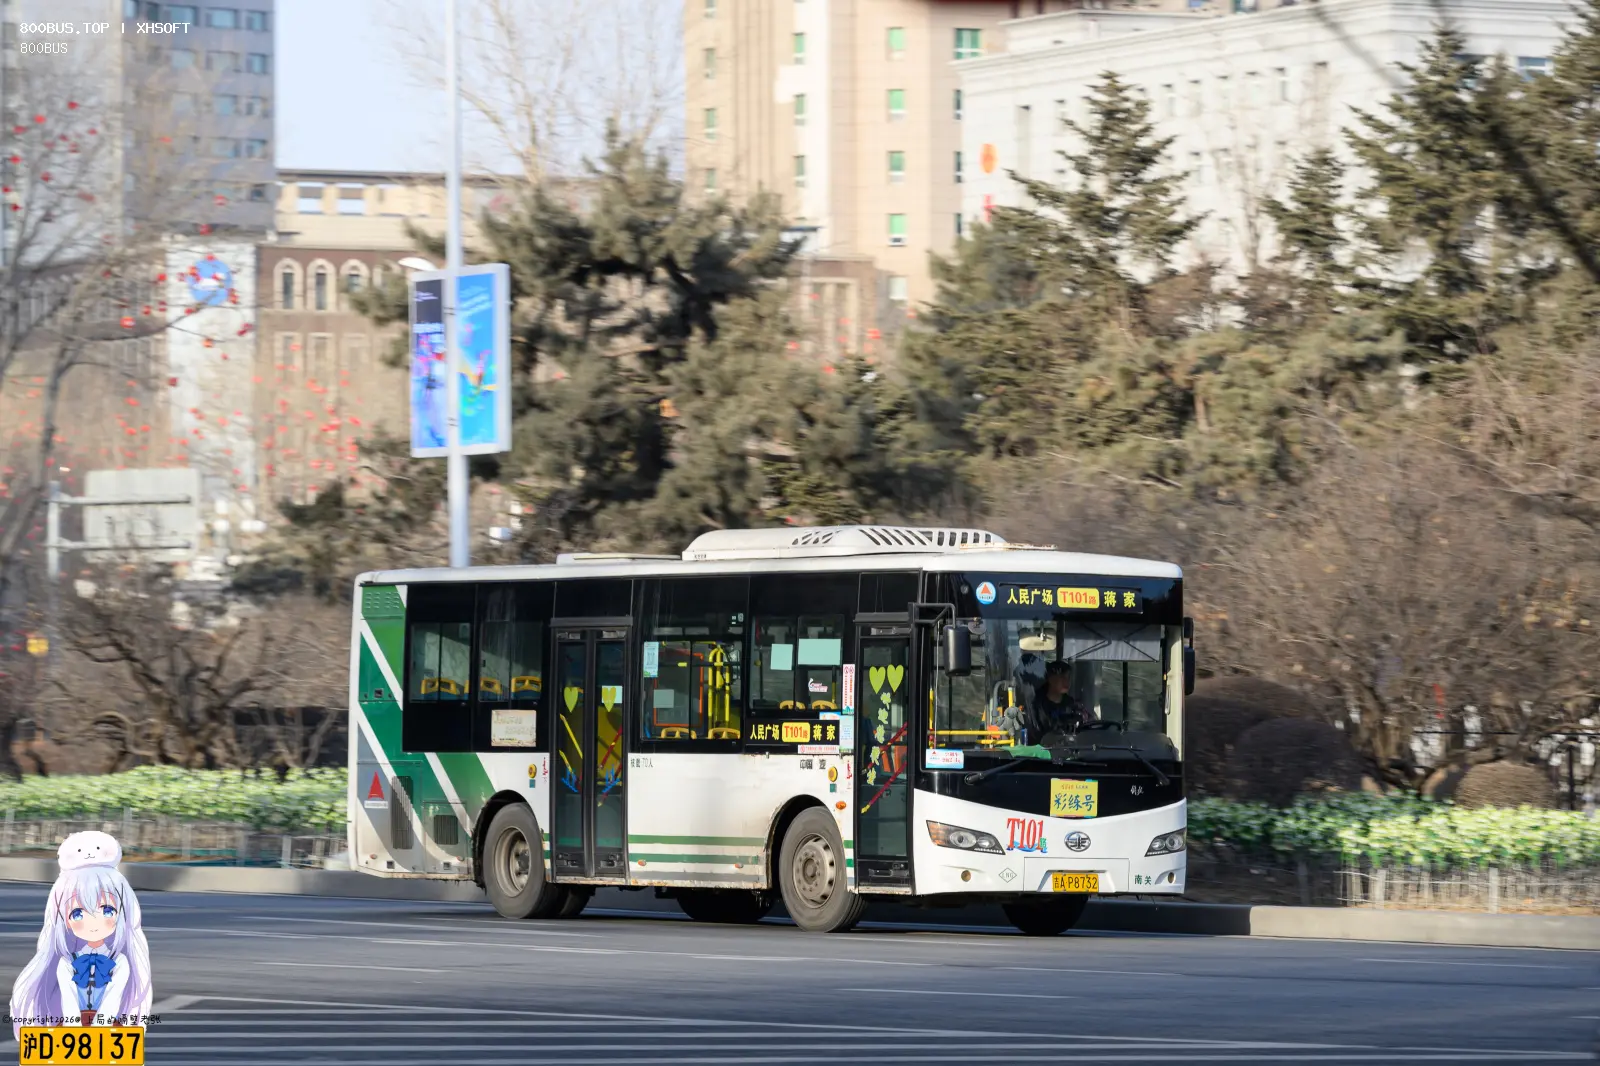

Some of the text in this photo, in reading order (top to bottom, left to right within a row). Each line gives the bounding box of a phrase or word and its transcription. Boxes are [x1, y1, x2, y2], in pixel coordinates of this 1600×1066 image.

[1006, 588, 1053, 605] 人民广场
[1103, 590, 1136, 608] 蒋家
[749, 724, 780, 740] 人民广场
[812, 724, 836, 741] 蒋家
[1054, 793, 1095, 812] 彩练号
[1134, 874, 1152, 886] 南关
